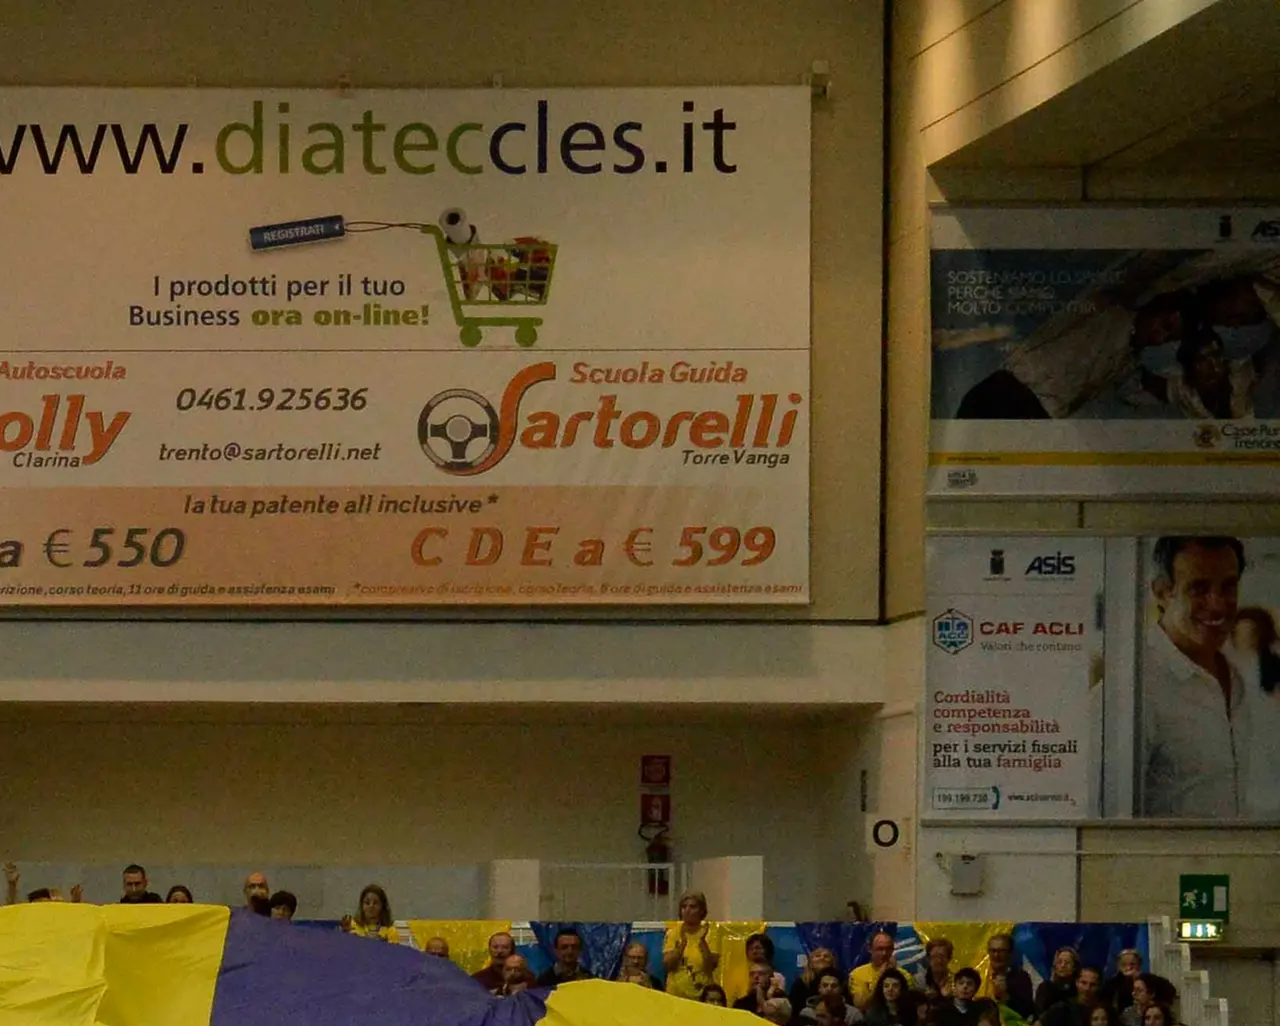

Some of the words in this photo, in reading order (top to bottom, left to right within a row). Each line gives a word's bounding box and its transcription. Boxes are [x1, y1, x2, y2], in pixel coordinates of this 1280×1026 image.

[263, 223, 326, 244] REGISTRATI
[155, 276, 159, 296] I
[171, 274, 276, 301] prodotti
[288, 281, 329, 301] per
[339, 274, 351, 295] il
[361, 277, 405, 295] tuo
[130, 305, 239, 325] Business
[252, 310, 302, 325] ora
[314, 303, 428, 325] on-line!
[570, 362, 665, 384] Scuola
[670, 361, 747, 383] Guida
[177, 388, 368, 410] 0461.925636
[435, 362, 801, 476] Sartorelli
[12, 452, 80, 467] Clarina
[159, 443, 381, 460] trento@sartorelli.net
[683, 450, 729, 464] Torre
[734, 450, 789, 468] Vanga
[185, 495, 205, 513] la
[211, 495, 246, 513] tua
[250, 495, 339, 518] patente
[344, 495, 373, 514] all
[43, 529, 72, 567] €
[84, 528, 185, 567] 550
[411, 528, 448, 566] C
[465, 528, 503, 565] D
[521, 527, 560, 566] E
[574, 539, 604, 566] a
[623, 528, 654, 567] €
[672, 527, 775, 566] 599
[980, 622, 1024, 635] CAF
[1032, 622, 1084, 635] ACLI
[934, 690, 1010, 704] Cordialità
[933, 707, 1031, 721] competenza
[947, 720, 1060, 736] responsabilità
[933, 743, 960, 756] per
[973, 740, 1026, 753] servizi
[1031, 740, 1077, 753] fiscali
[933, 755, 960, 768] alla
[967, 756, 992, 768] tua
[997, 755, 1062, 772] famiglia
